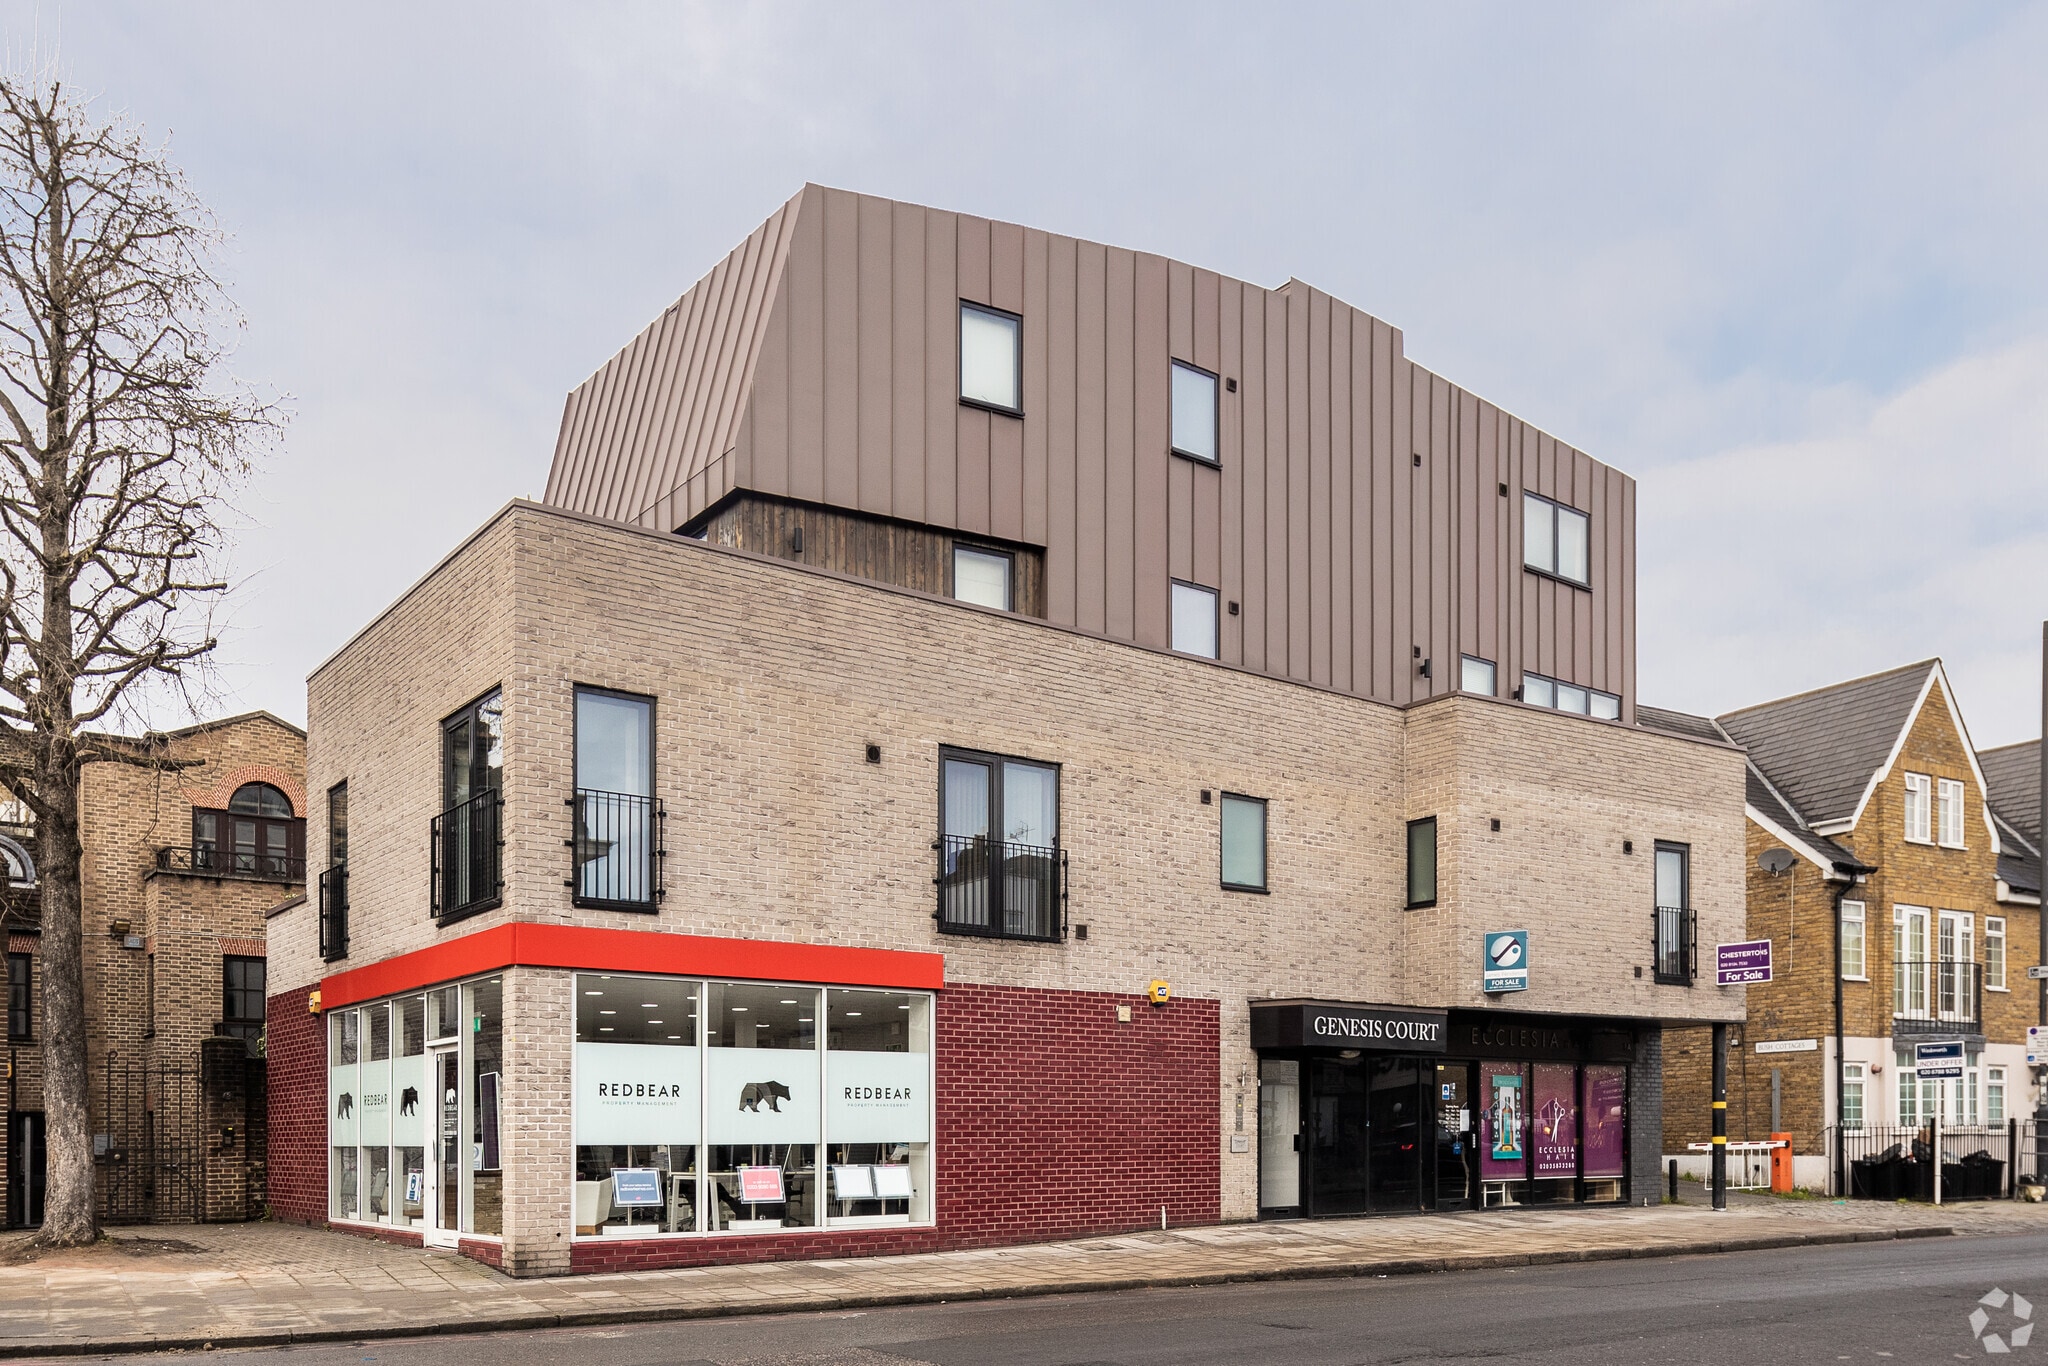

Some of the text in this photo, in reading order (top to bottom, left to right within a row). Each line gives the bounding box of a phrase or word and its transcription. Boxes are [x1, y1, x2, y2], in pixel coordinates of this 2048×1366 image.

[1720, 948, 1768, 959] CHESTERTONS
[1726, 970, 1764, 981] For Sale
[1314, 1016, 1439, 1041] GENESIS COURT
[1471, 1027, 1559, 1048] ECCLESIA
[1775, 1042, 1806, 1050] COTTAGES
[599, 1083, 680, 1097] REDBEAR
[844, 1087, 911, 1100] REDBEAR
[364, 1093, 387, 1106] REDBEAR
[1539, 1146, 1575, 1154] ECCLESIA
